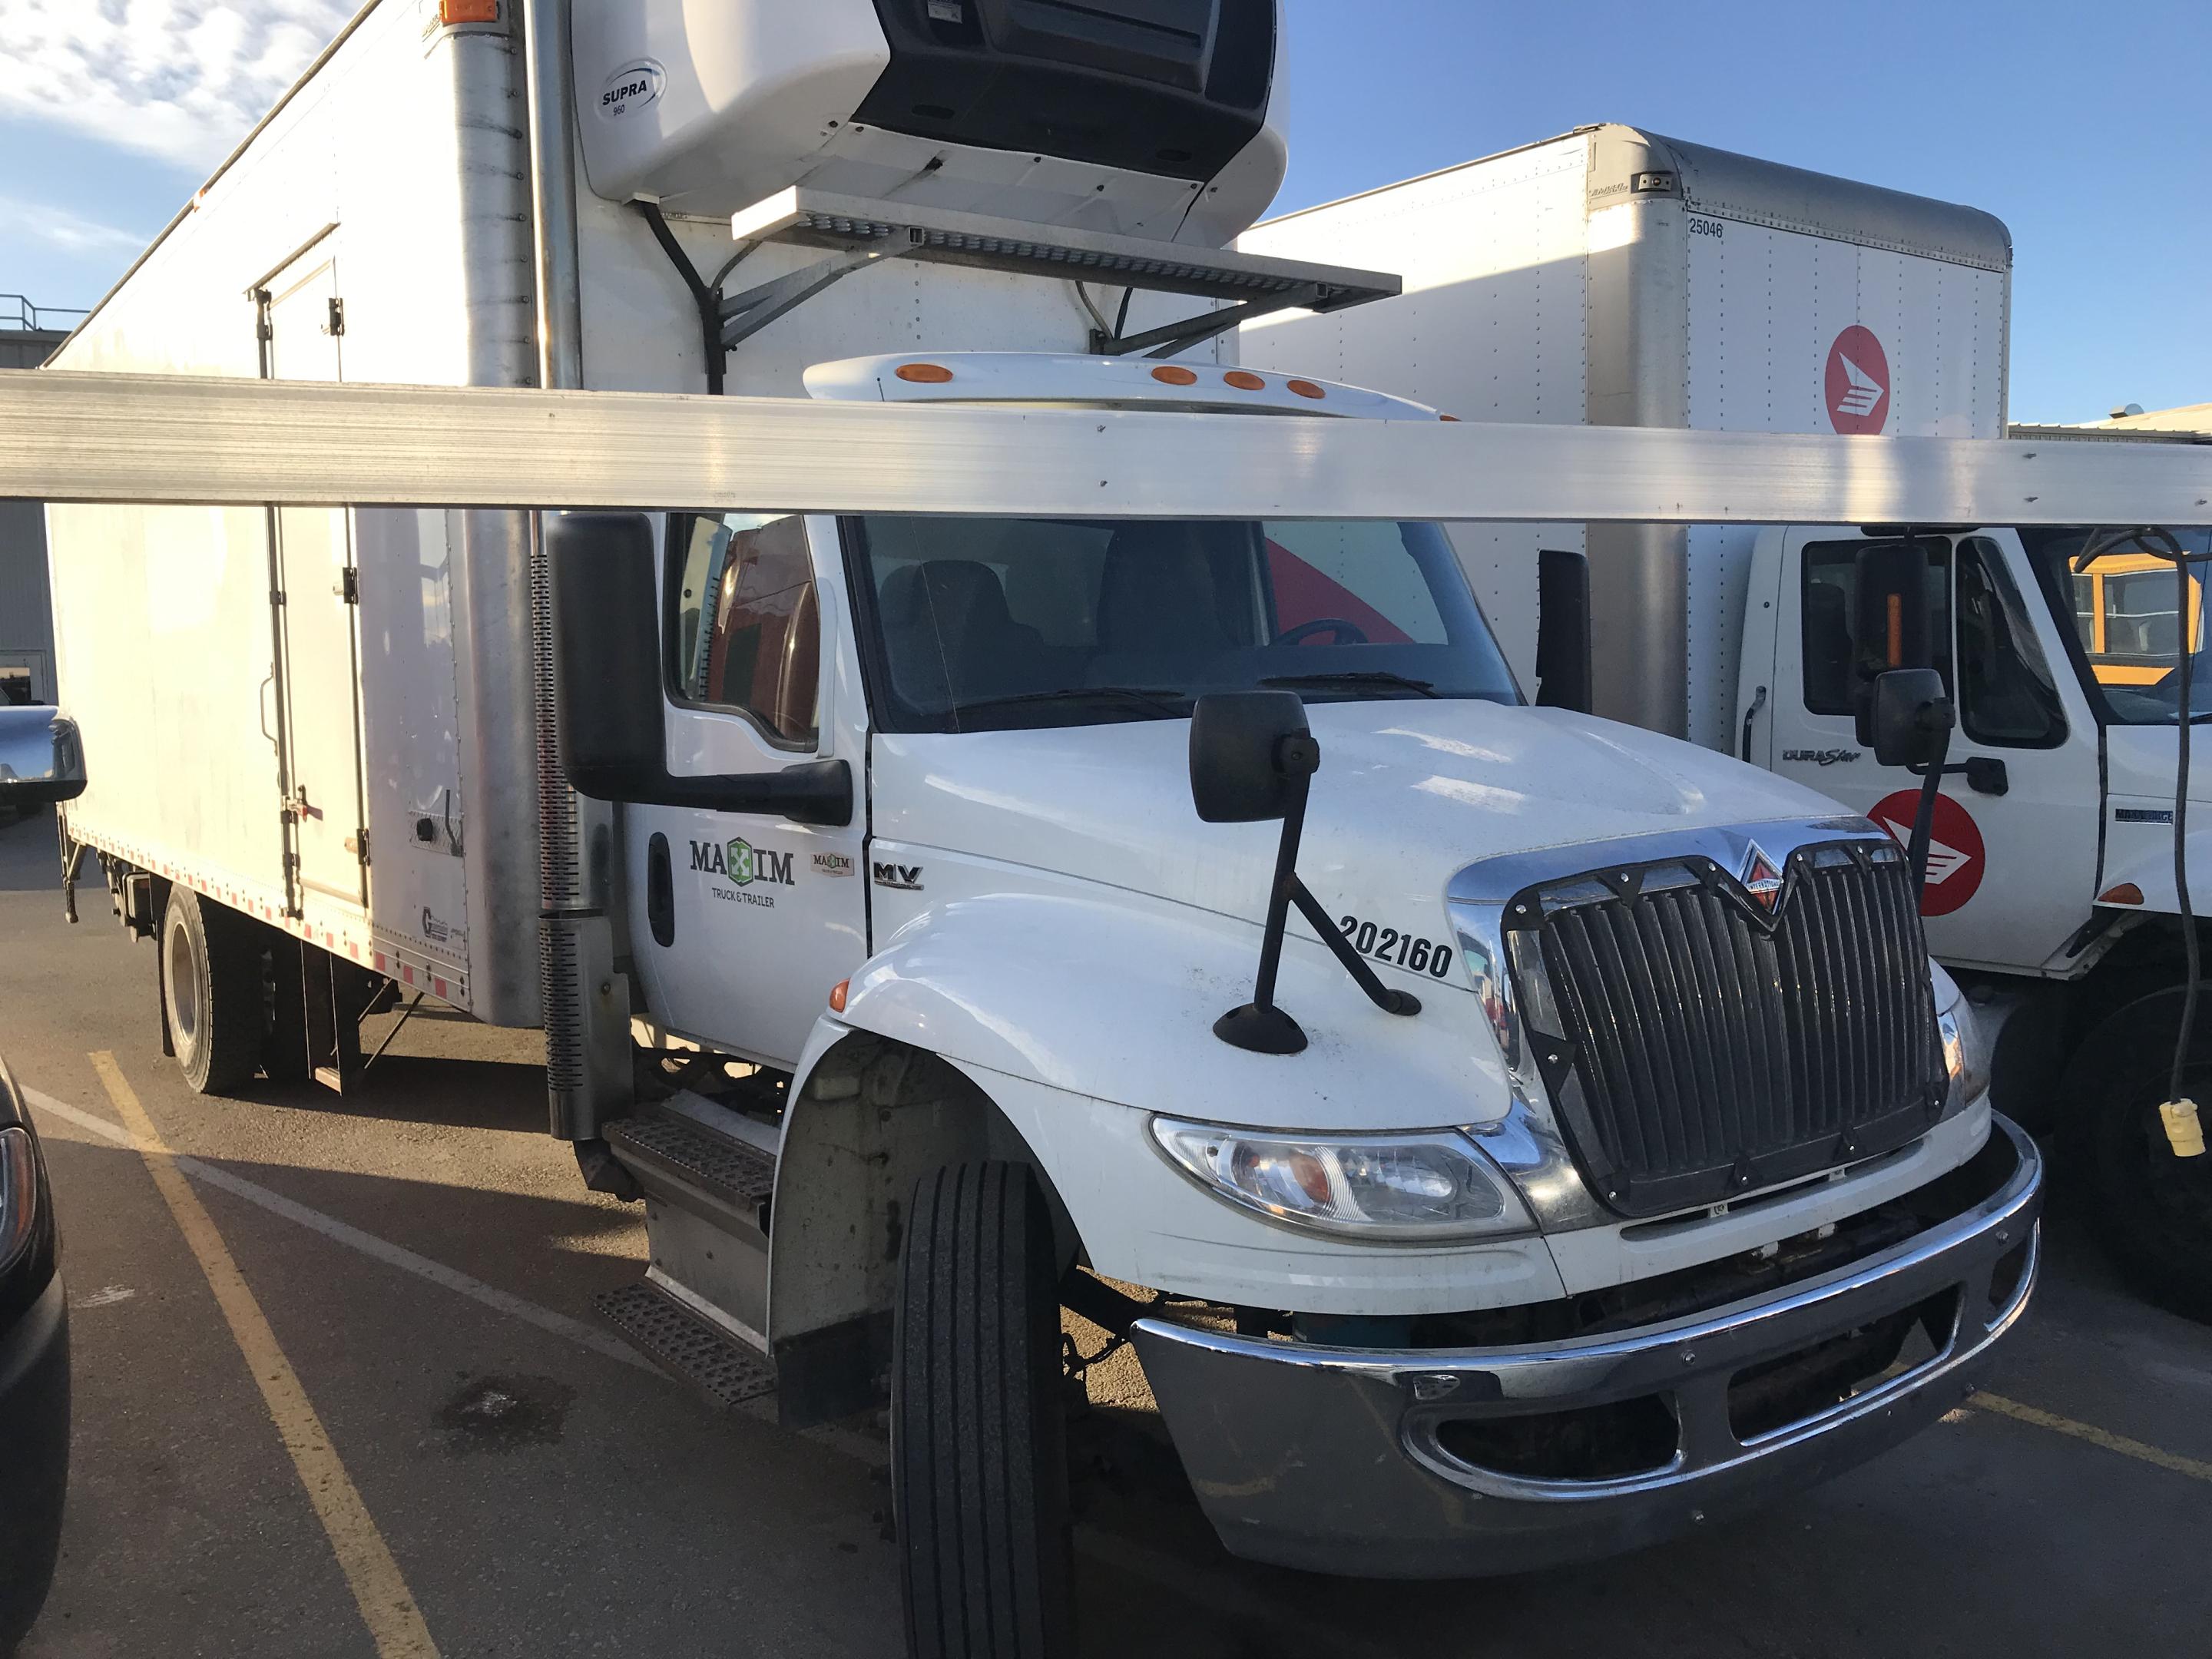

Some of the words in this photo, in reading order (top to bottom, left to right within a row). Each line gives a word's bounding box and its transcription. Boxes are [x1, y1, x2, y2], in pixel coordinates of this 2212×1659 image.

[602, 80, 647, 106] SUPRA
[613, 104, 625, 117] 960
[1690, 217, 1724, 238] 25046
[689, 836, 796, 887] MAXIM
[813, 853, 849, 869] MAXIM
[873, 861, 924, 883] MV
[711, 887, 737, 902] TRUCK
[742, 892, 775, 908] TRAILER
[1339, 916, 1452, 978] 202160
